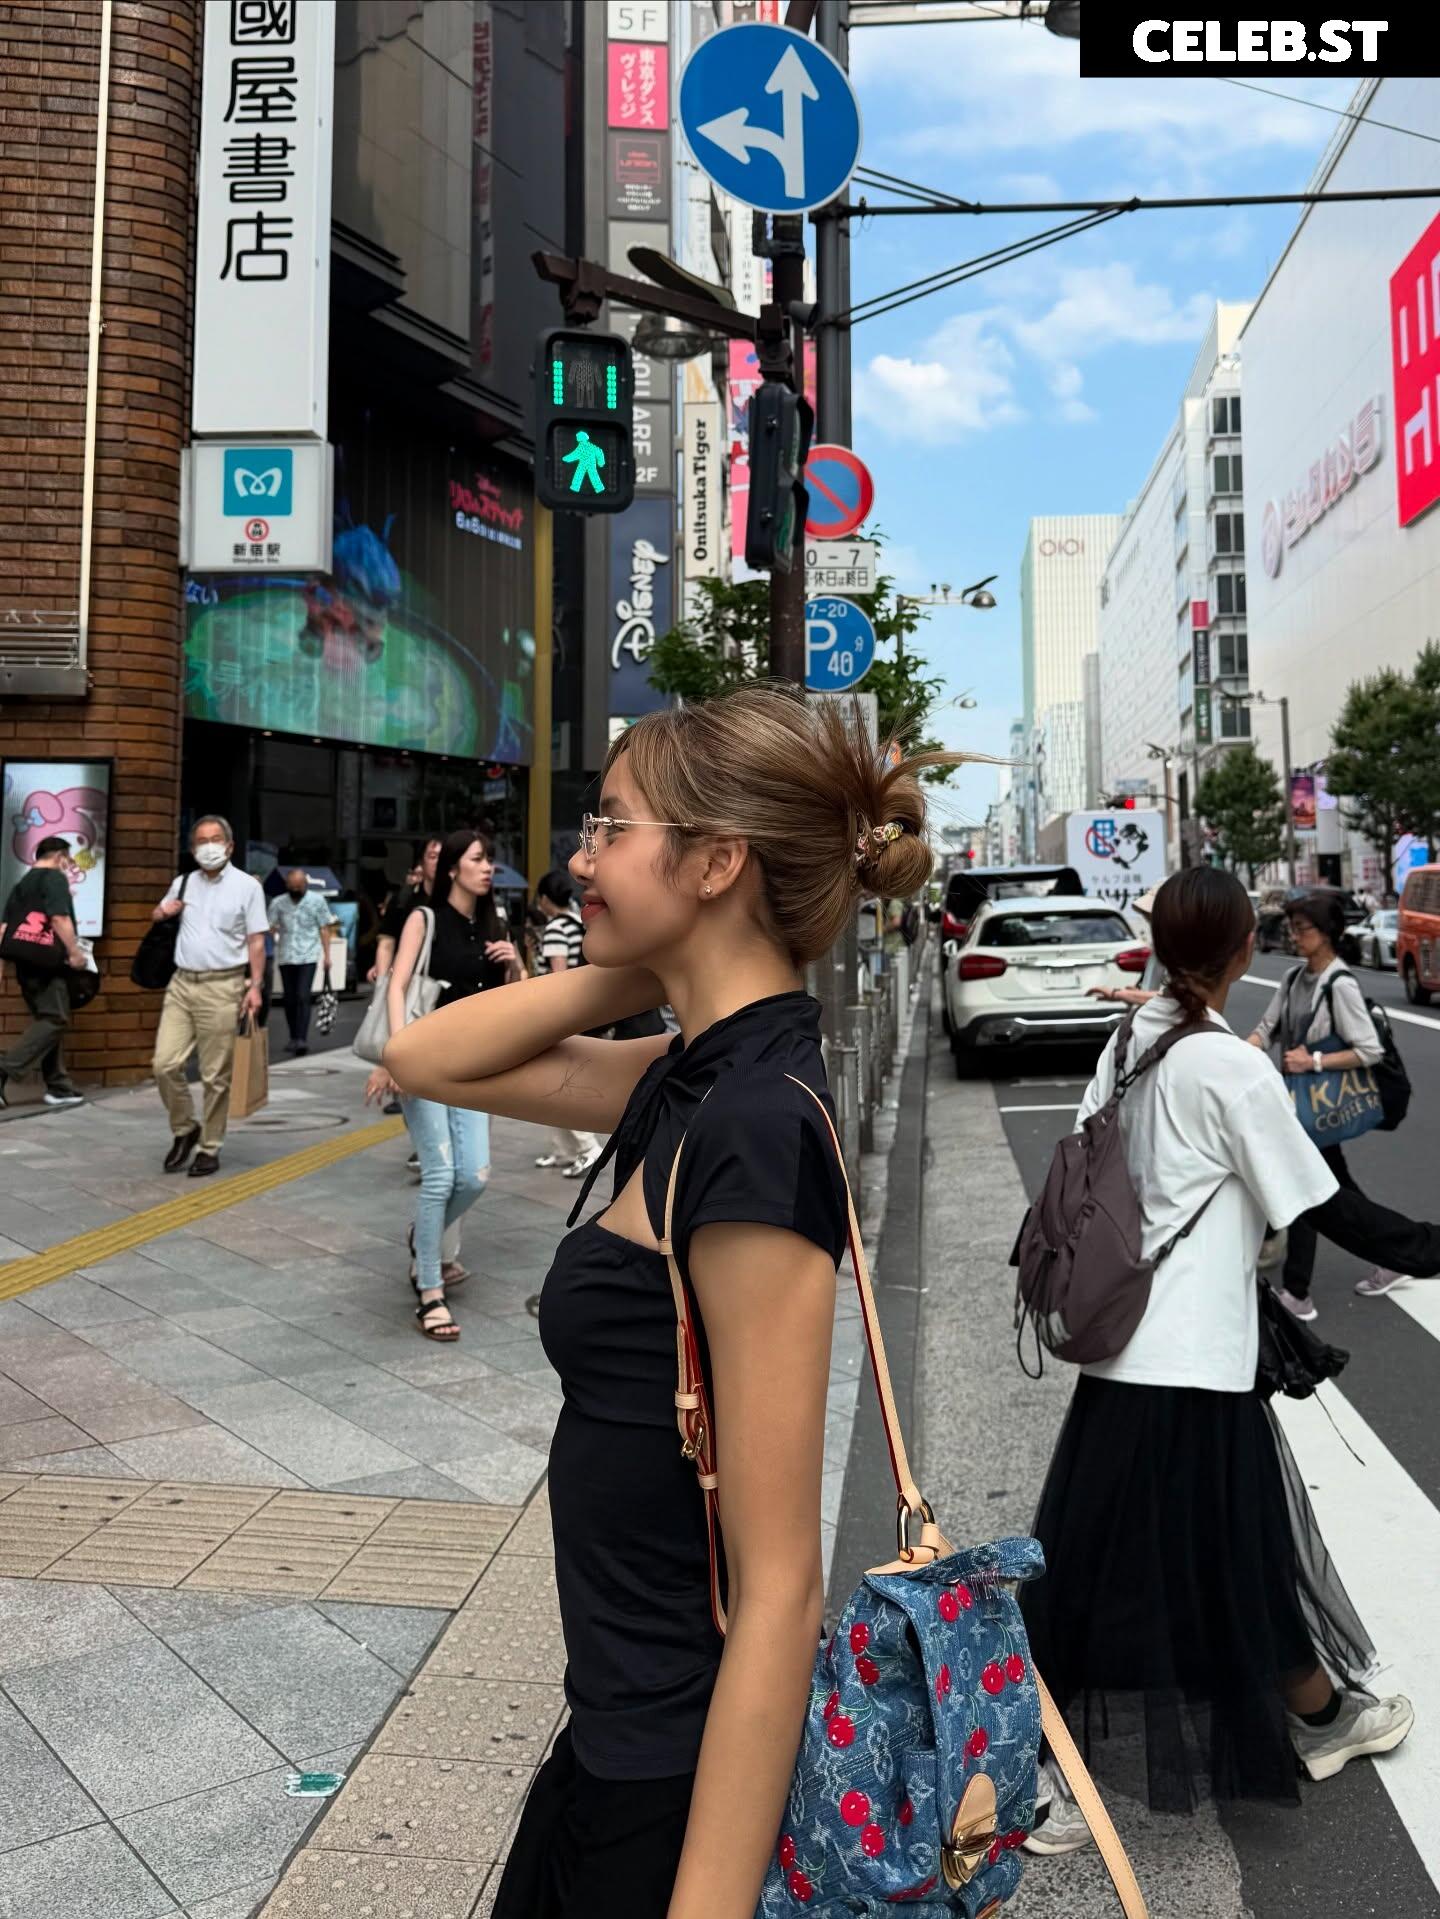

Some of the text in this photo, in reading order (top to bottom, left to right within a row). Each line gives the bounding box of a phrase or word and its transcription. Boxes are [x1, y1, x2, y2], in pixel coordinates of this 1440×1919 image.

[639, 47, 656, 126] 東京ダンス
[220, 0, 298, 281] 國屋書店
[636, 466, 658, 484] 2F
[233, 543, 280, 556] 新宿駅
[612, 539, 669, 670] Disney
[809, 603, 848, 618] 7-20
[805, 619, 838, 677] P
